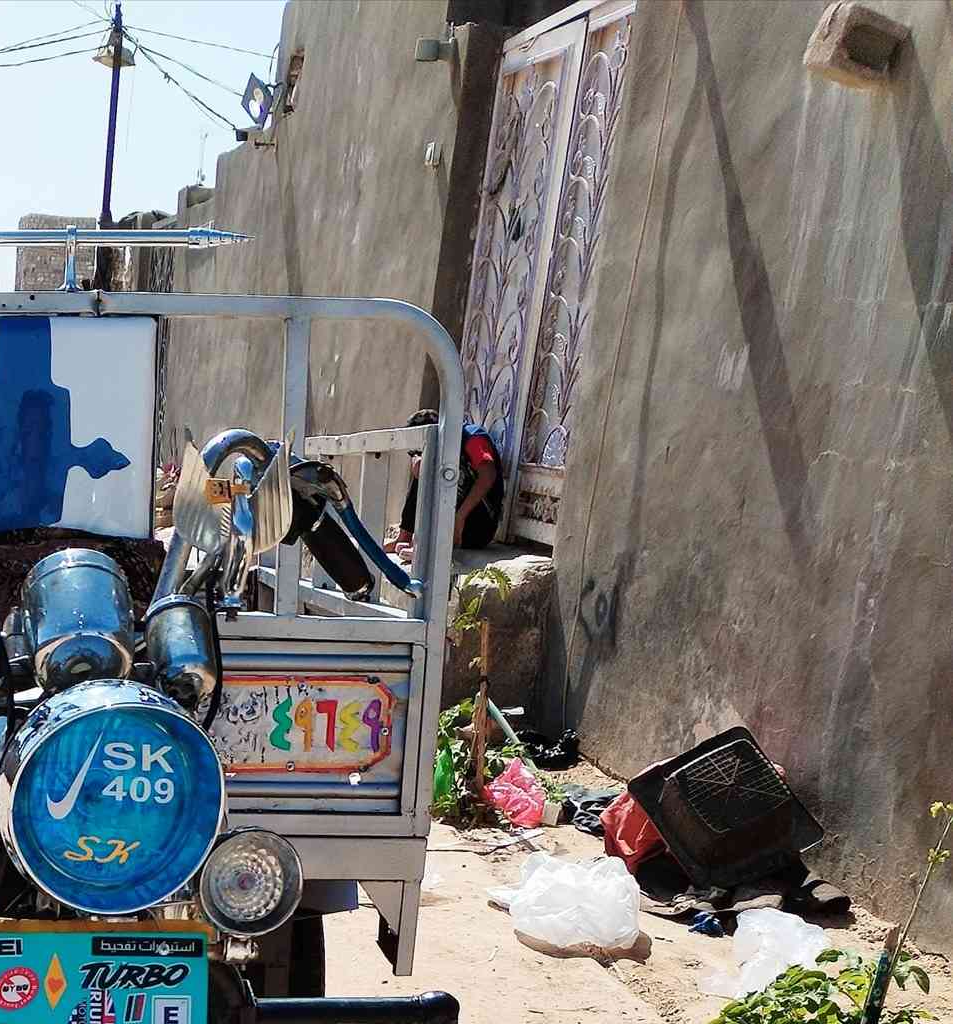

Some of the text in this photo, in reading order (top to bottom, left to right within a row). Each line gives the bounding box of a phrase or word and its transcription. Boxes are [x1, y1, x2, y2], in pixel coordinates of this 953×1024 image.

[102, 742, 175, 773] SK
[101, 776, 175, 804] 409
[79, 961, 191, 991] TURBO
[164, 1006, 179, 1024] E
